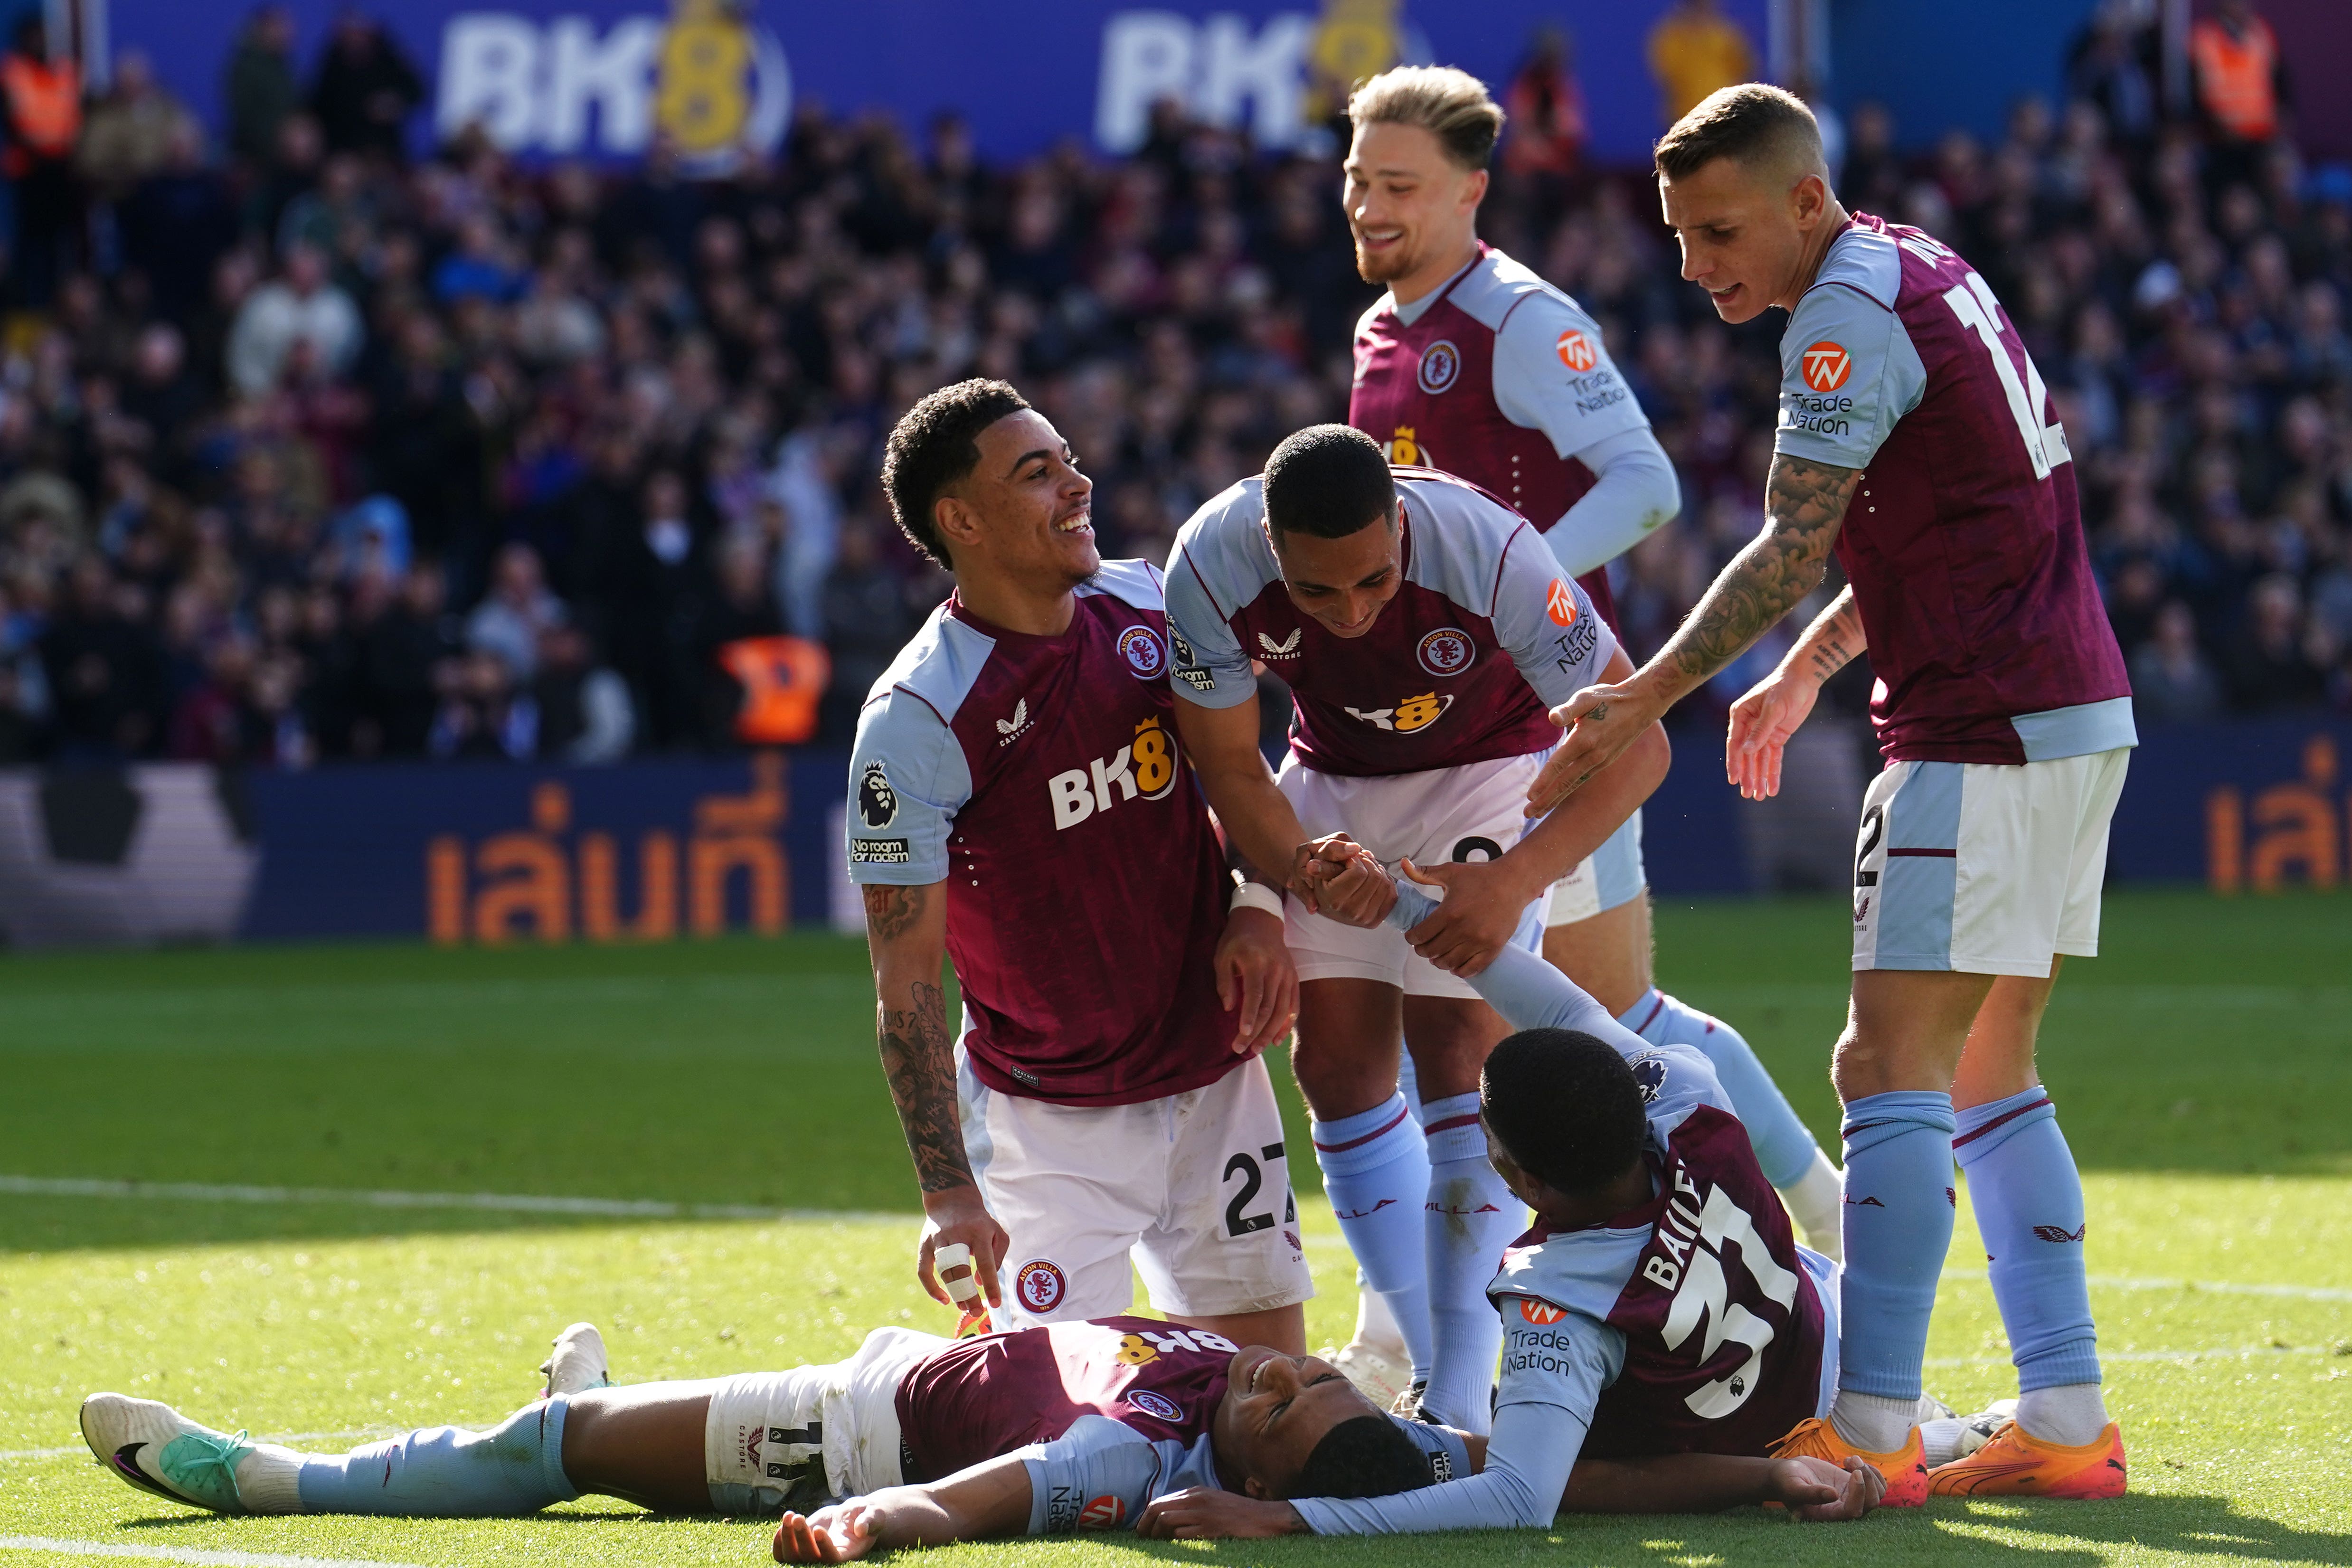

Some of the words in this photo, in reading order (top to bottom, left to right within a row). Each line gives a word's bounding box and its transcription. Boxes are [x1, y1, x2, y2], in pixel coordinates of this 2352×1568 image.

[438, 12, 748, 157] BK8
[1576, 387, 1626, 417] Natio
[1791, 394, 1852, 413] Trade
[1787, 410, 1849, 435] Nation
[1121, 632, 1134, 652] ASTON
[1133, 630, 1152, 639] VILLA
[1424, 632, 1443, 648] ASTON
[1445, 632, 1464, 641] VILLA
[1556, 625, 1596, 674] Natio
[1260, 651, 1301, 660] CASTORE
[999, 720, 1036, 747] CASTORE
[1048, 728, 1172, 831] BK8
[851, 850, 868, 862] for
[869, 851, 909, 862] racism
[852, 839, 869, 852] No
[869, 841, 902, 852] room
[1643, 1158, 1702, 1291] BAILE
[1020, 1263, 1037, 1282] ASTON
[1038, 1263, 1058, 1275] VILLA
[1661, 1182, 1799, 1419] 31
[1511, 1330, 1569, 1351] Trade
[1508, 1350, 1569, 1377] Nation
